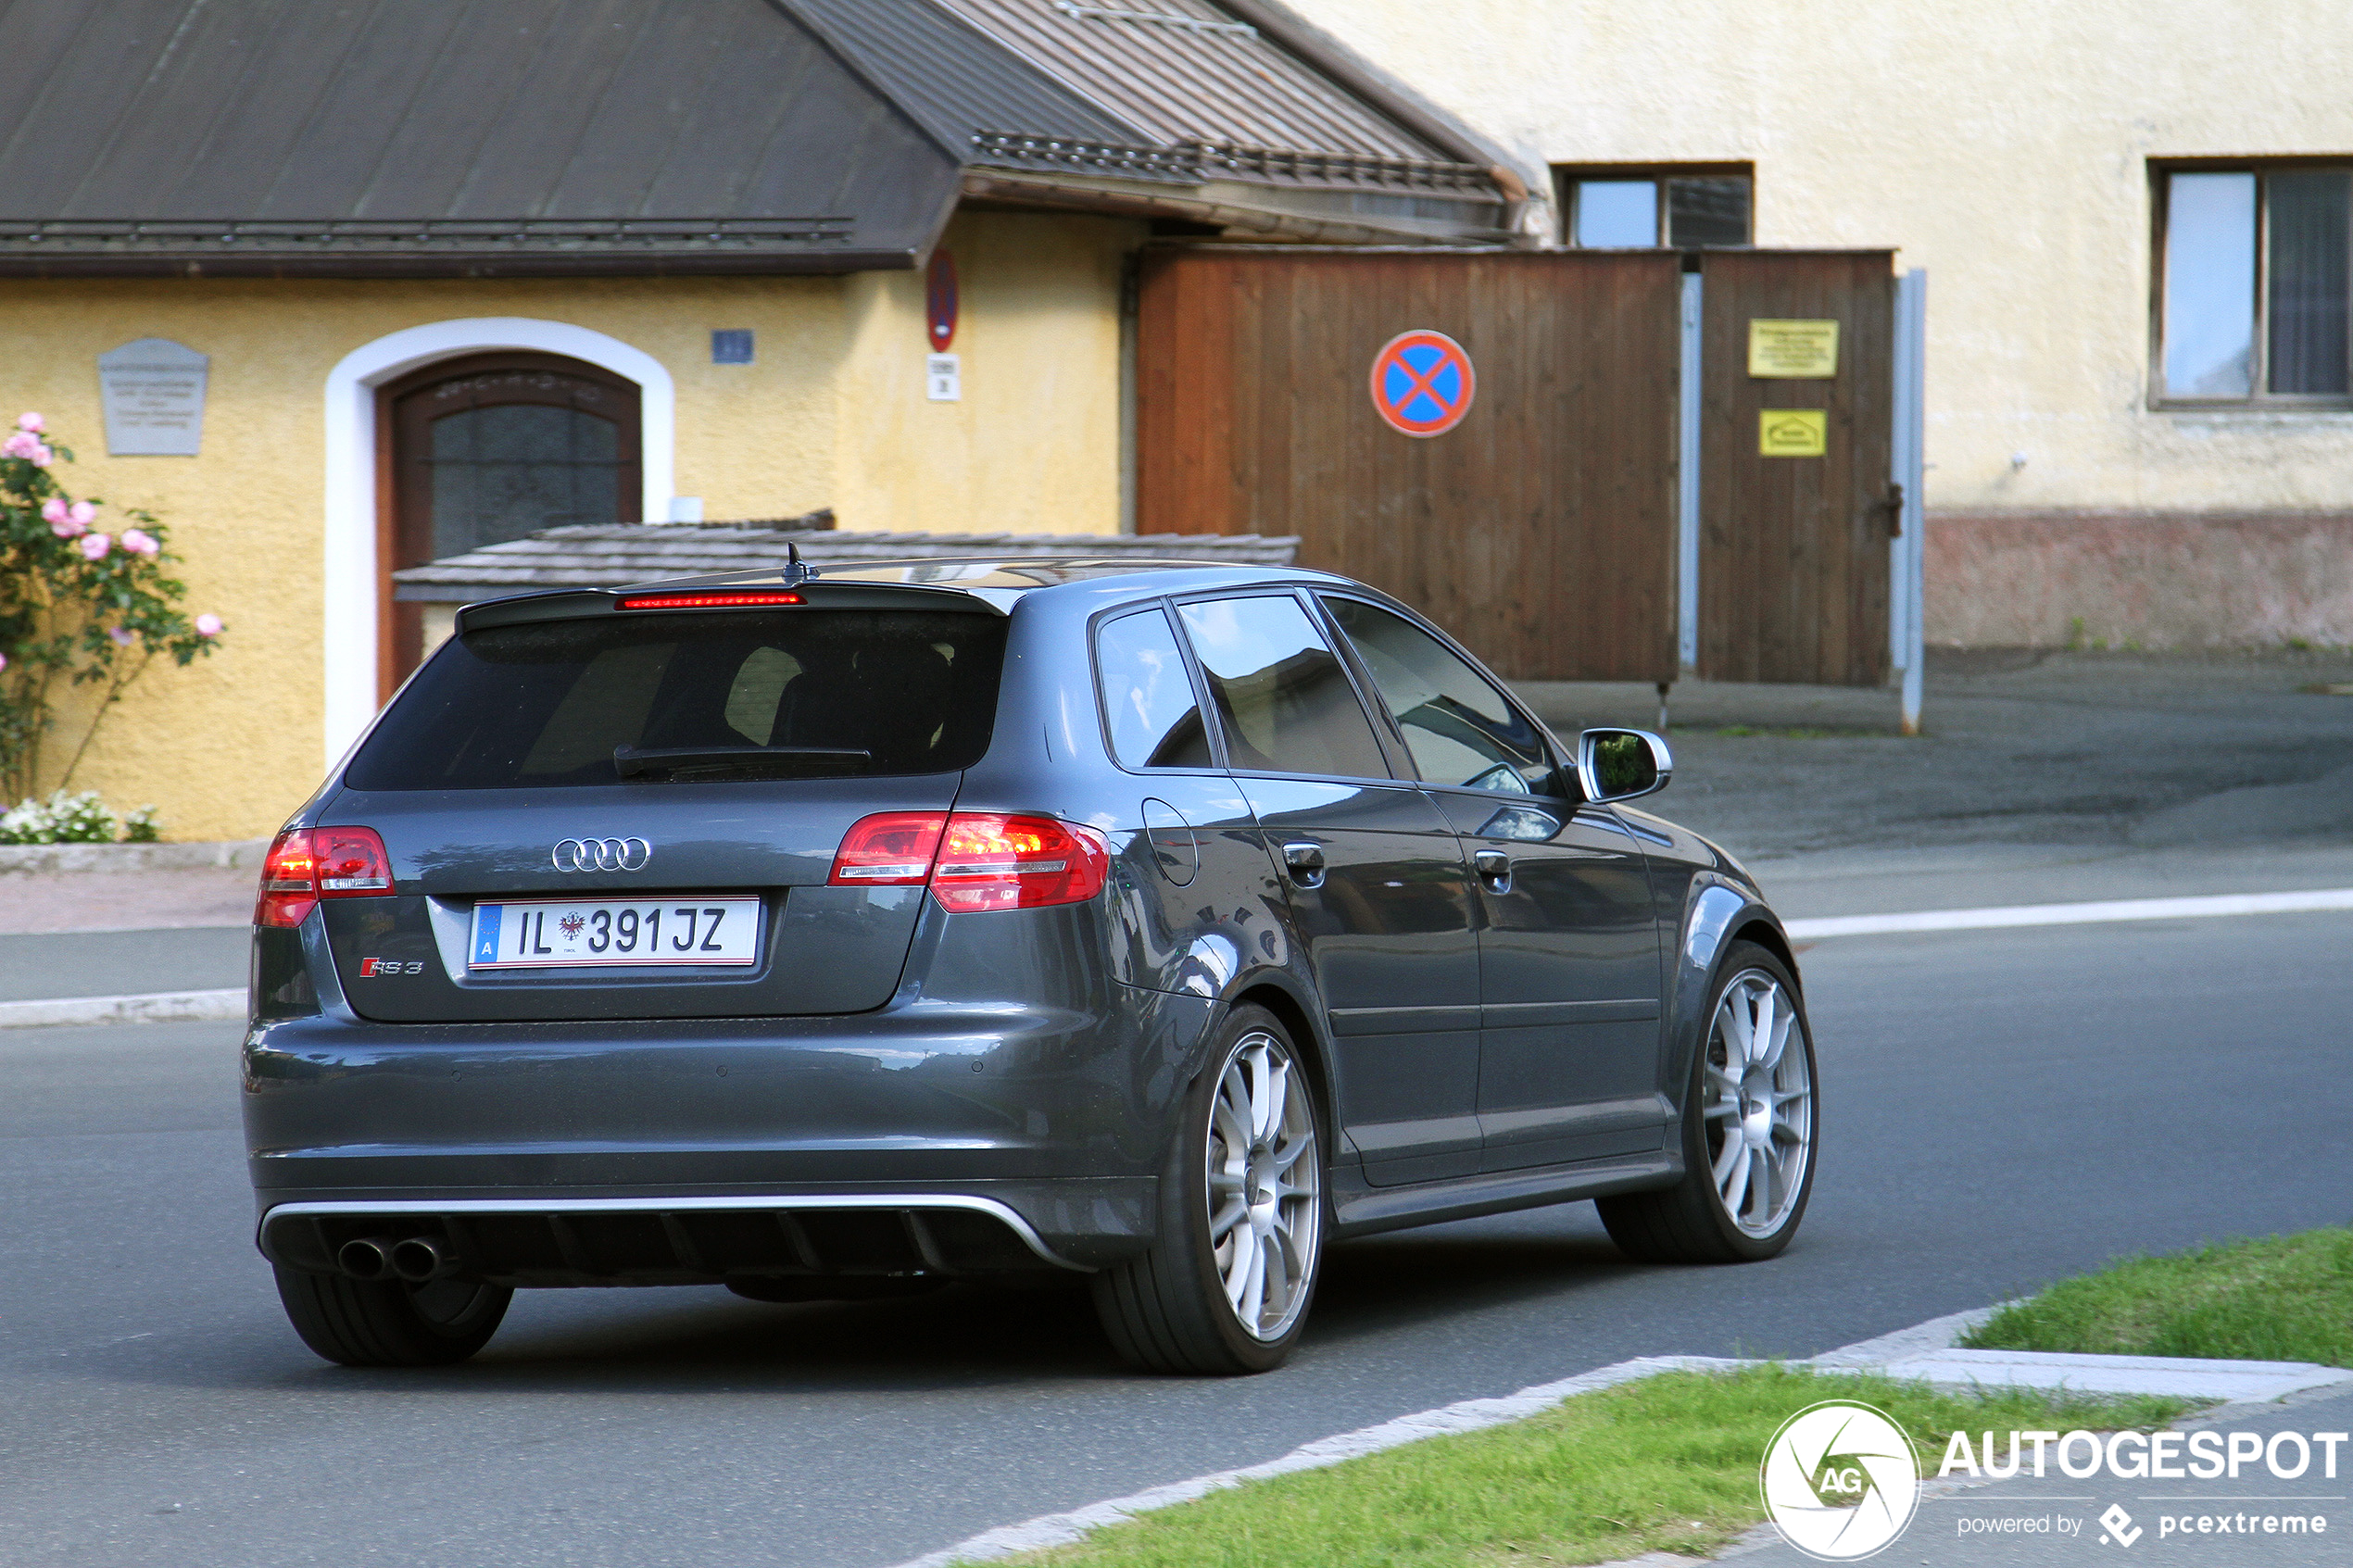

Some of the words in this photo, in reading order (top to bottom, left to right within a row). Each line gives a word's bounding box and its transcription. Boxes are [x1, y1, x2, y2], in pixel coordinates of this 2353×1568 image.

[519, 911, 552, 955] IL
[587, 909, 661, 953] 391
[673, 909, 726, 952] JZ
[481, 942, 493, 955] A
[404, 961, 423, 975] 3
